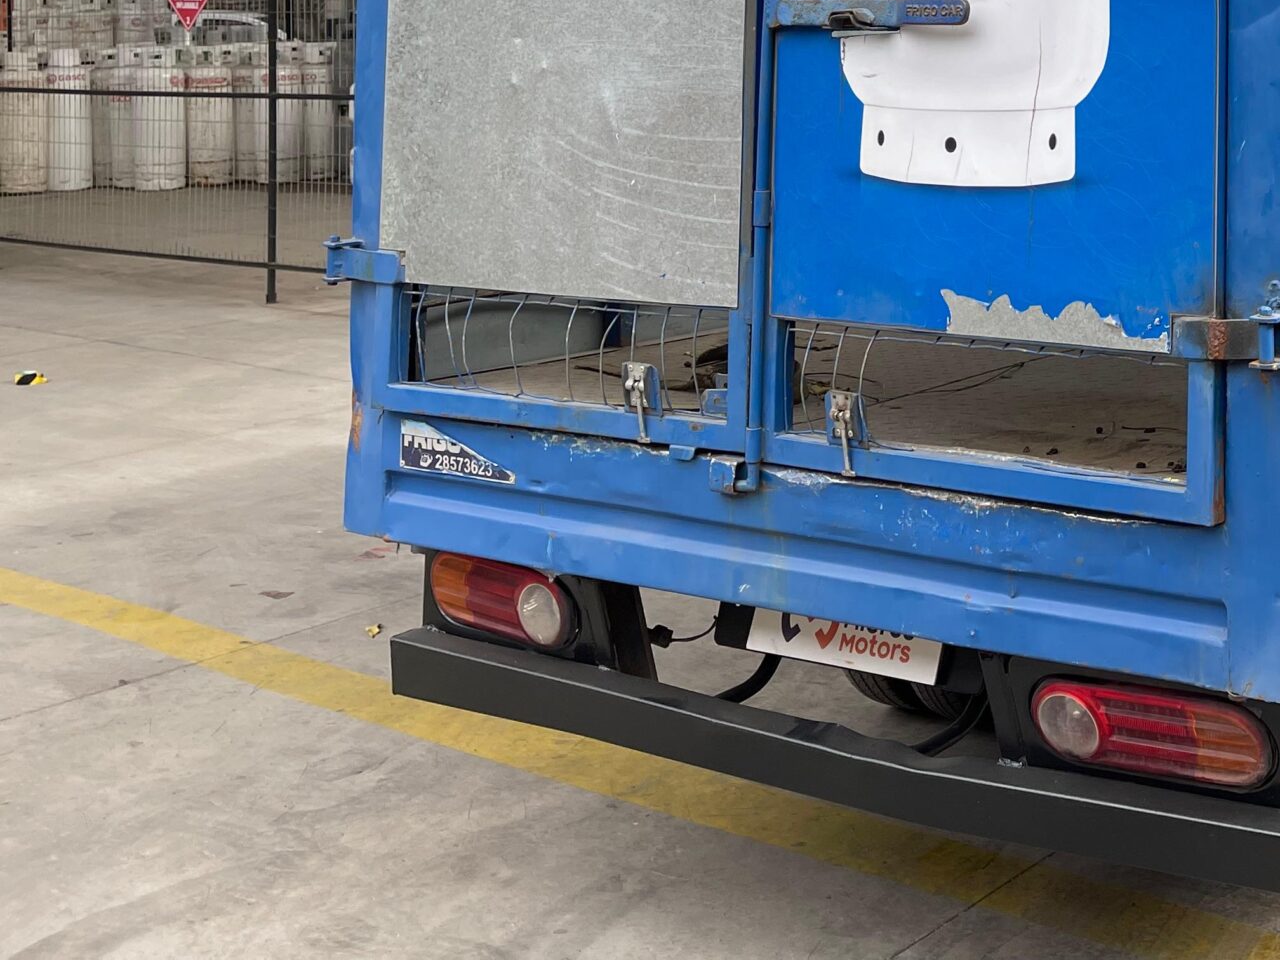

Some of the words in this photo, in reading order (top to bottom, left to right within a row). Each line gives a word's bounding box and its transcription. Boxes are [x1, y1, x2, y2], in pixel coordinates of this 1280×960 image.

[906, 4, 937, 18] FRIGO
[941, 4, 964, 18] CAR
[434, 453, 493, 477] 28573623
[838, 632, 912, 664] Motors
